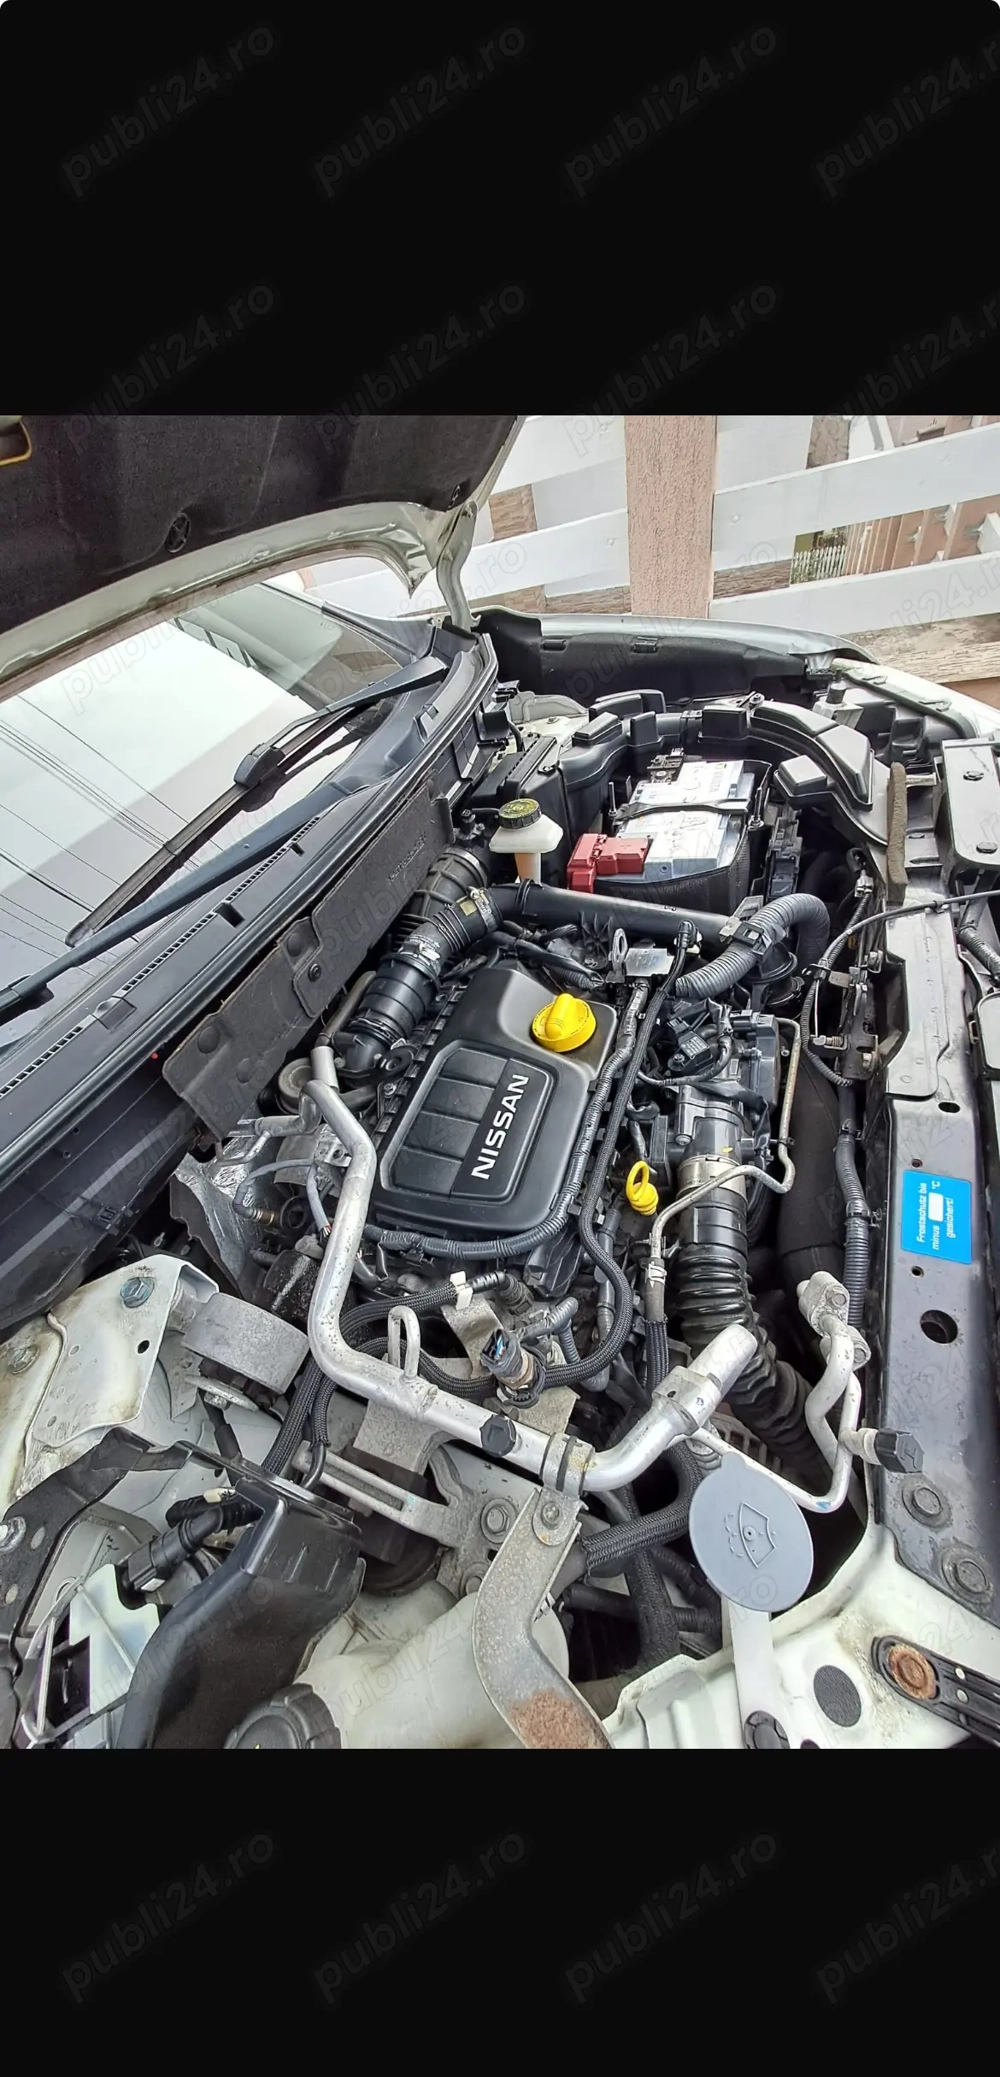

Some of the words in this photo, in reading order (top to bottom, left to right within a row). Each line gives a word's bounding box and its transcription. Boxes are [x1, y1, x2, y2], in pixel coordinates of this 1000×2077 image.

[470, 1074, 530, 1180] NISSAN
[917, 1182, 927, 1194] bis
[916, 1195, 927, 1243] Frostschutz
[930, 1225, 940, 1250] minus
[944, 1197, 956, 1239] gesichert!
